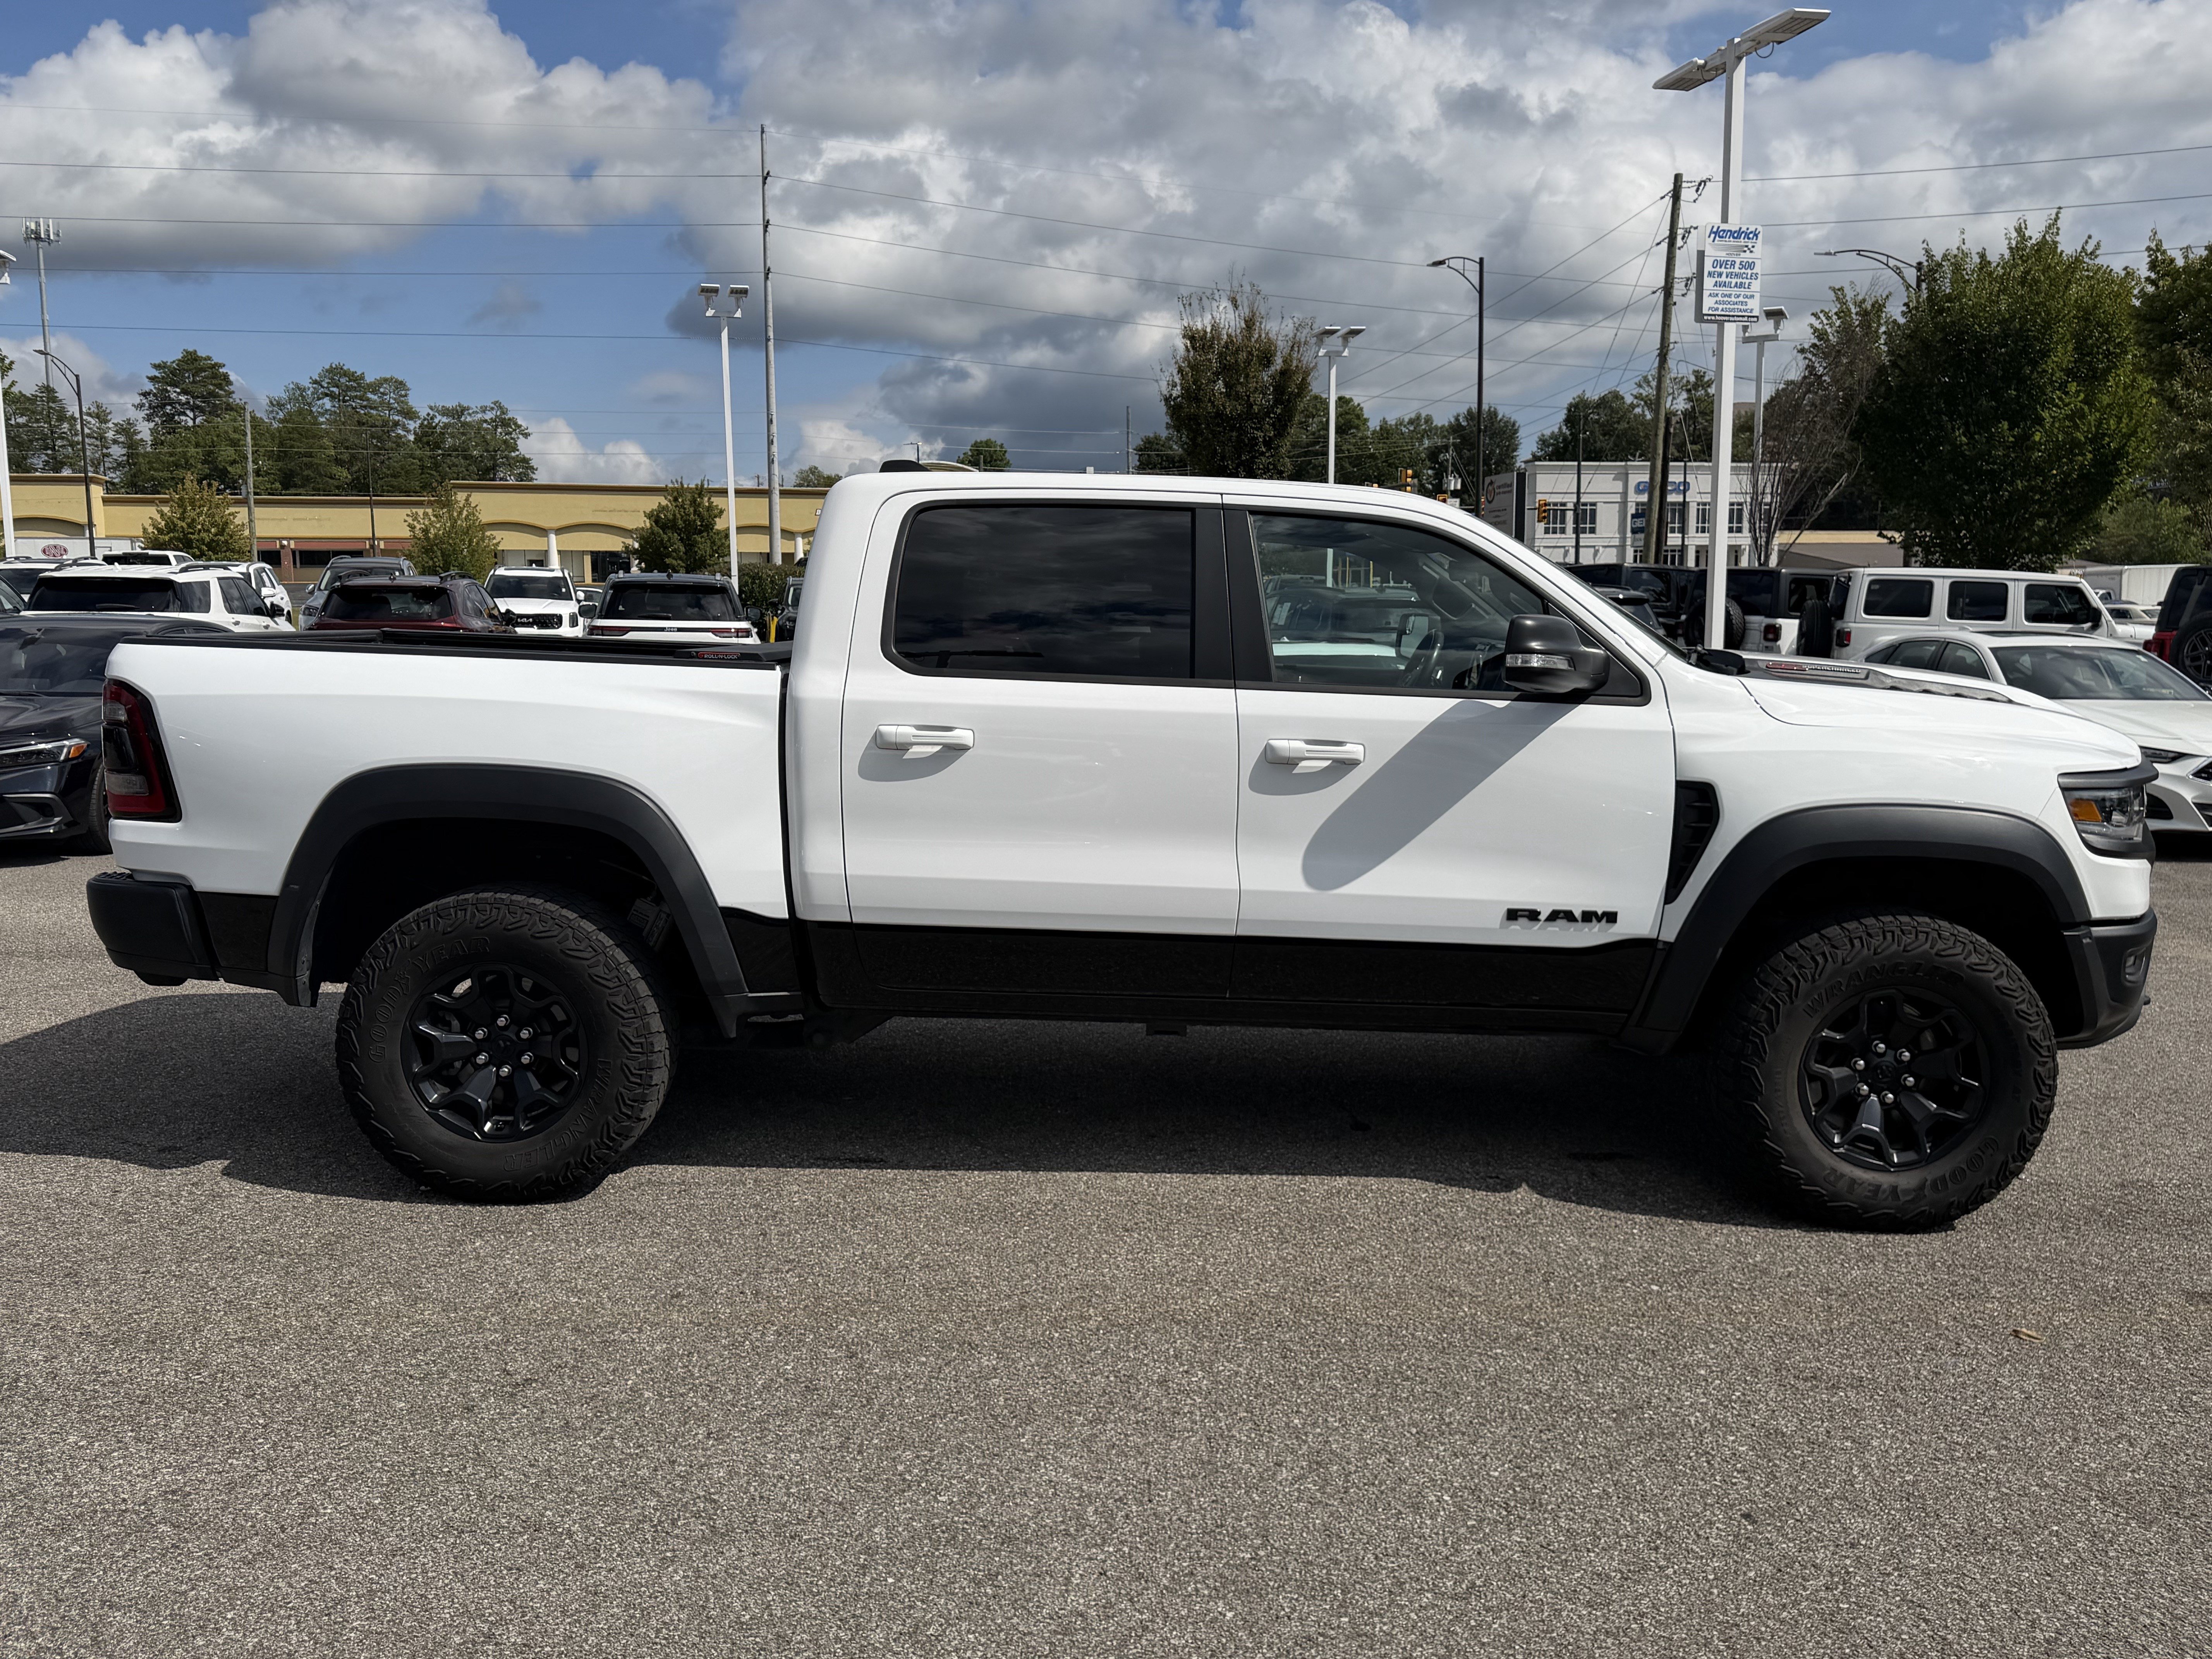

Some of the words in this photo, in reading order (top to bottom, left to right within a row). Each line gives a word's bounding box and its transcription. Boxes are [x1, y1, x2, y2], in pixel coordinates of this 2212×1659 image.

[1708, 225, 1760, 242] Hendrick
[1712, 259, 1736, 270] OVER
[1738, 261, 1755, 270] 500
[1726, 271, 1759, 280] VEHICLES
[1713, 280, 1752, 289] AVAILABLE
[1506, 908, 1618, 923] RAM
[1802, 960, 1965, 1018] WRANGLER
